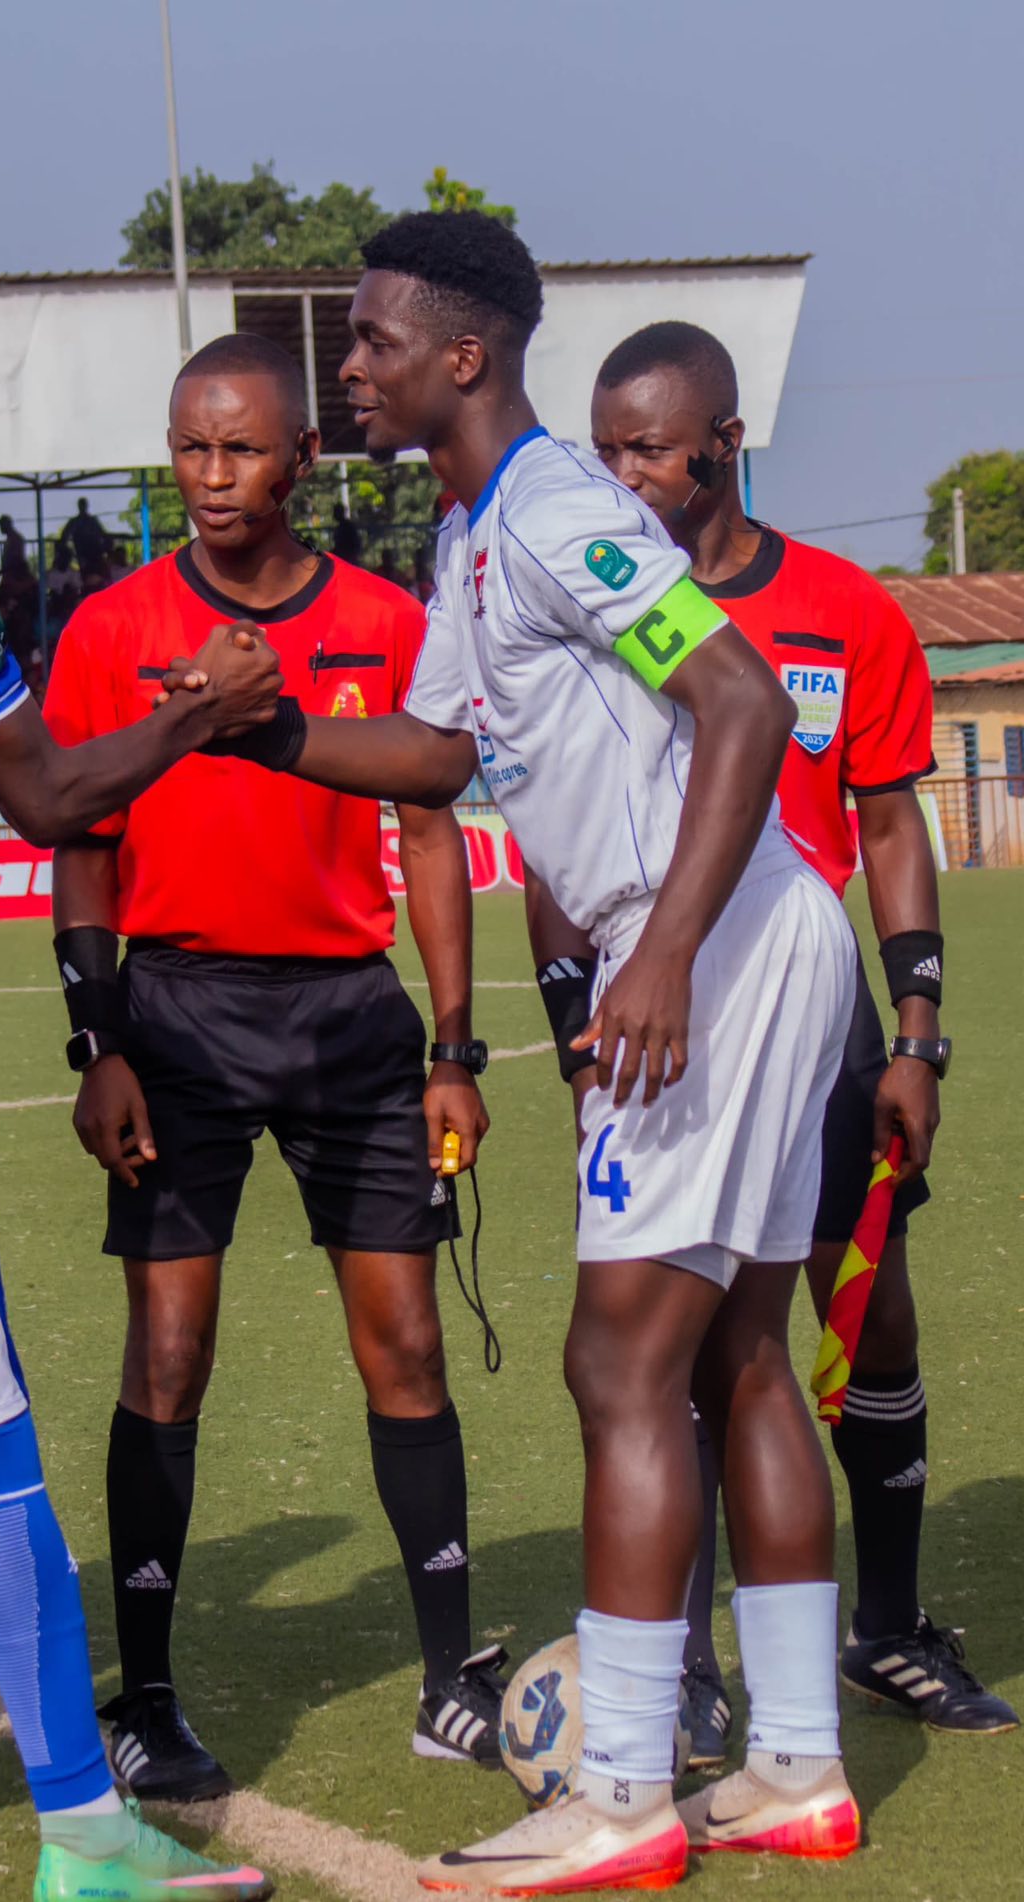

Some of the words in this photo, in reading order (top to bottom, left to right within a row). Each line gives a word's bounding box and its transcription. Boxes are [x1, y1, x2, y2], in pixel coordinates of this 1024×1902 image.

[634, 609, 685, 666] C
[787, 671, 838, 694] FIFA
[801, 734, 825, 746] 2025
[586, 1123, 631, 1212] 4
[126, 1577, 172, 1589] adidas
